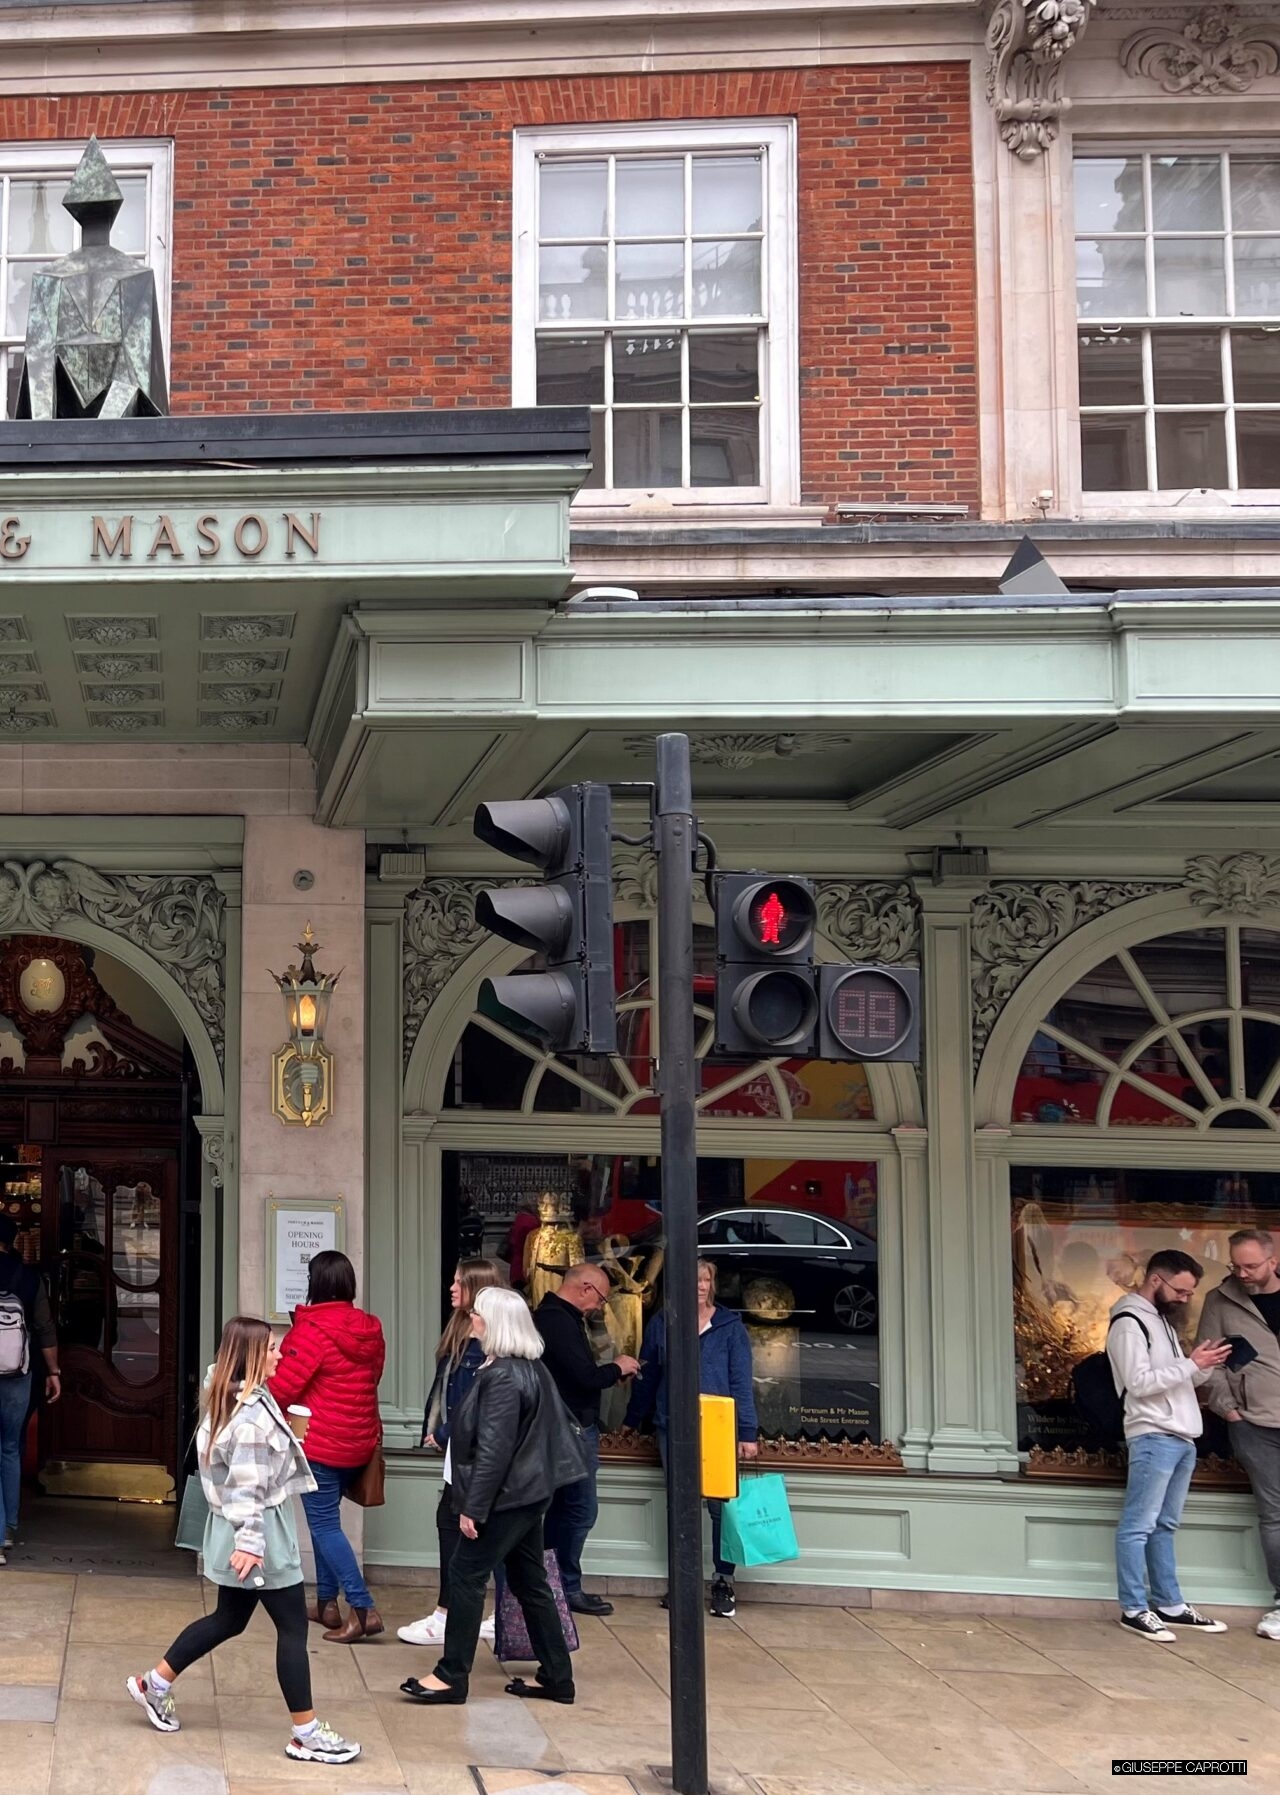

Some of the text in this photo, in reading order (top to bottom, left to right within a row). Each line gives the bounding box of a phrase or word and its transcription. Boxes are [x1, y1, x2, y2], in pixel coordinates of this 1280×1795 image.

[90, 512, 323, 560] MASON
[287, 1230, 324, 1240] OPENING
[291, 1240, 320, 1249] HOURS
[789, 1406, 799, 1414] Mr
[800, 1406, 828, 1415] Fortnum
[829, 1407, 835, 1415] &
[848, 1408, 870, 1416] Mason
[801, 1415, 870, 1425] Duke Street Entrance
